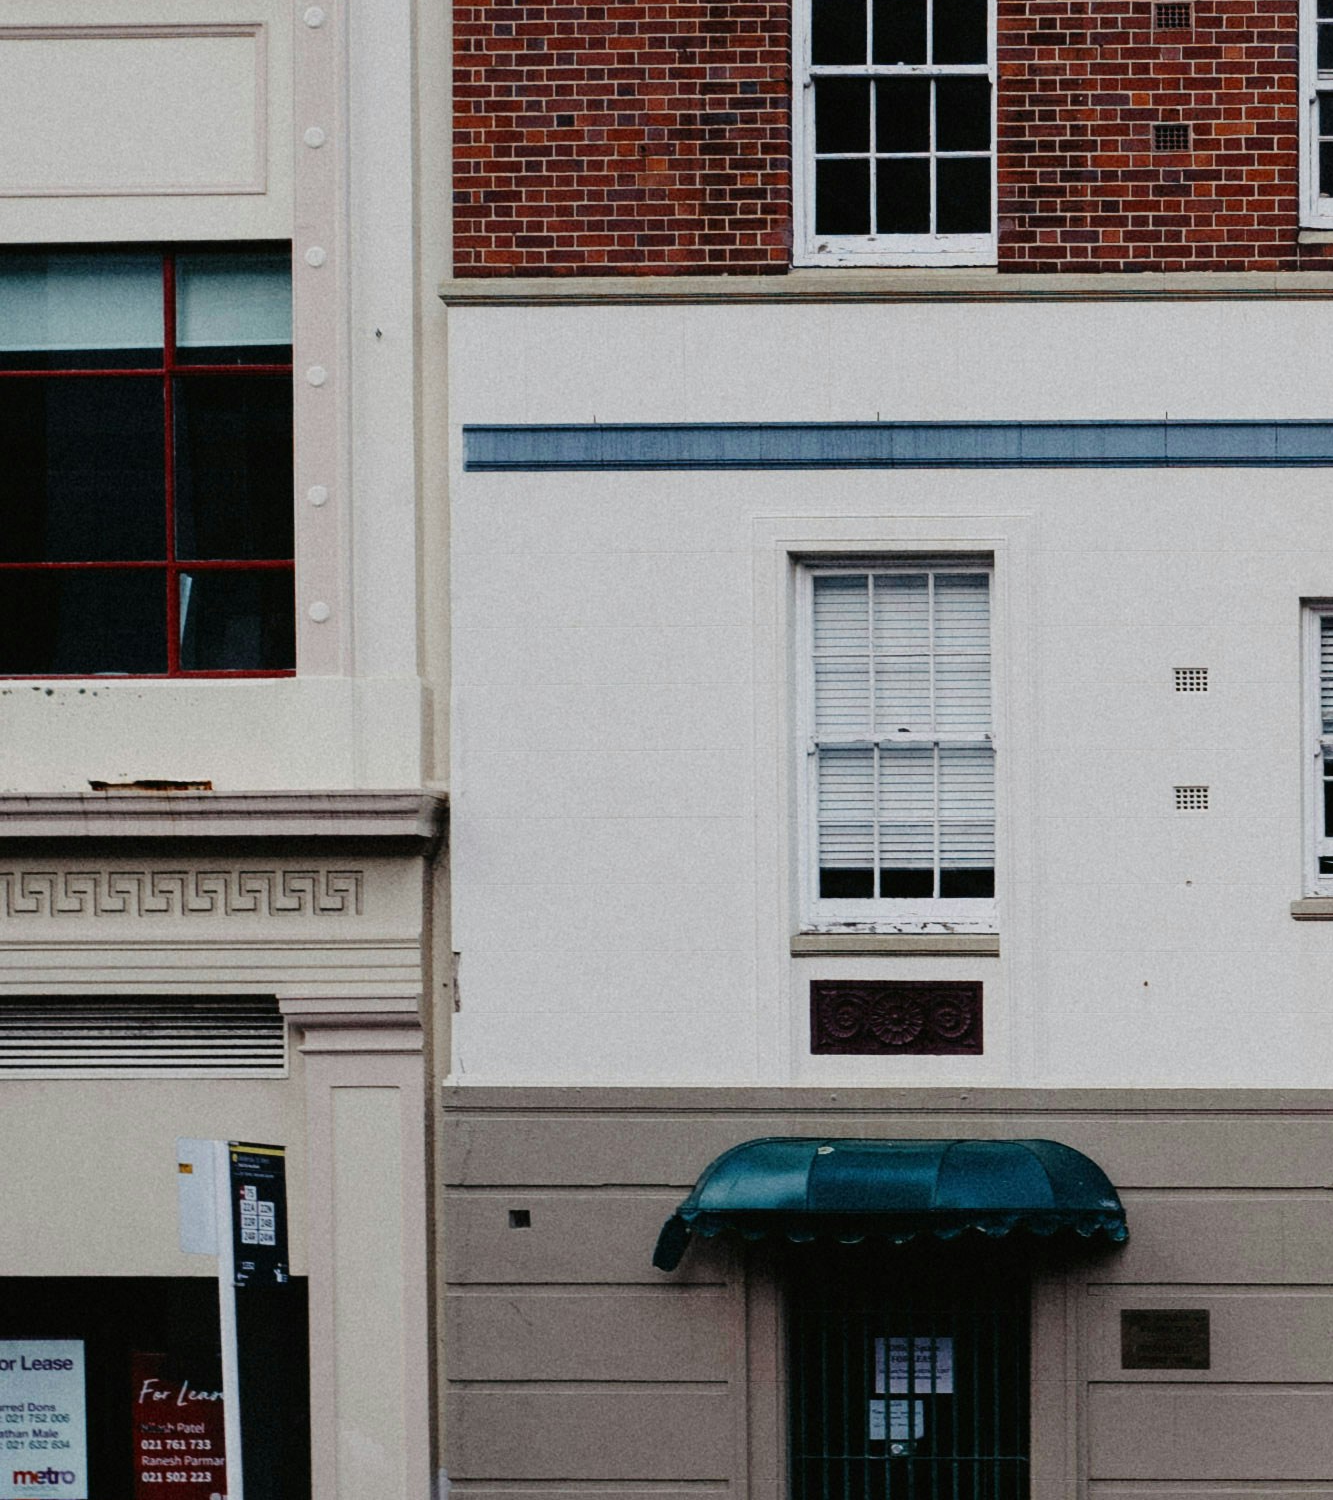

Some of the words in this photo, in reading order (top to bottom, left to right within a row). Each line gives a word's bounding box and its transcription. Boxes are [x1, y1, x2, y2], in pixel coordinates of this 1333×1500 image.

[21, 1355, 74, 1371] Lease
[138, 1378, 171, 1404] For
[28, 1402, 56, 1412] Dons
[5, 1413, 24, 1423] 021
[29, 1413, 47, 1423] 752
[177, 1422, 205, 1433] Patel
[6, 1440, 24, 1449] 021
[141, 1439, 162, 1450] 021
[166, 1439, 186, 1450] 761
[190, 1439, 212, 1450] 733
[13, 1466, 76, 1485] metro
[142, 1471, 162, 1482] 021
[166, 1471, 187, 1482] 502
[190, 1471, 212, 1482] 223
